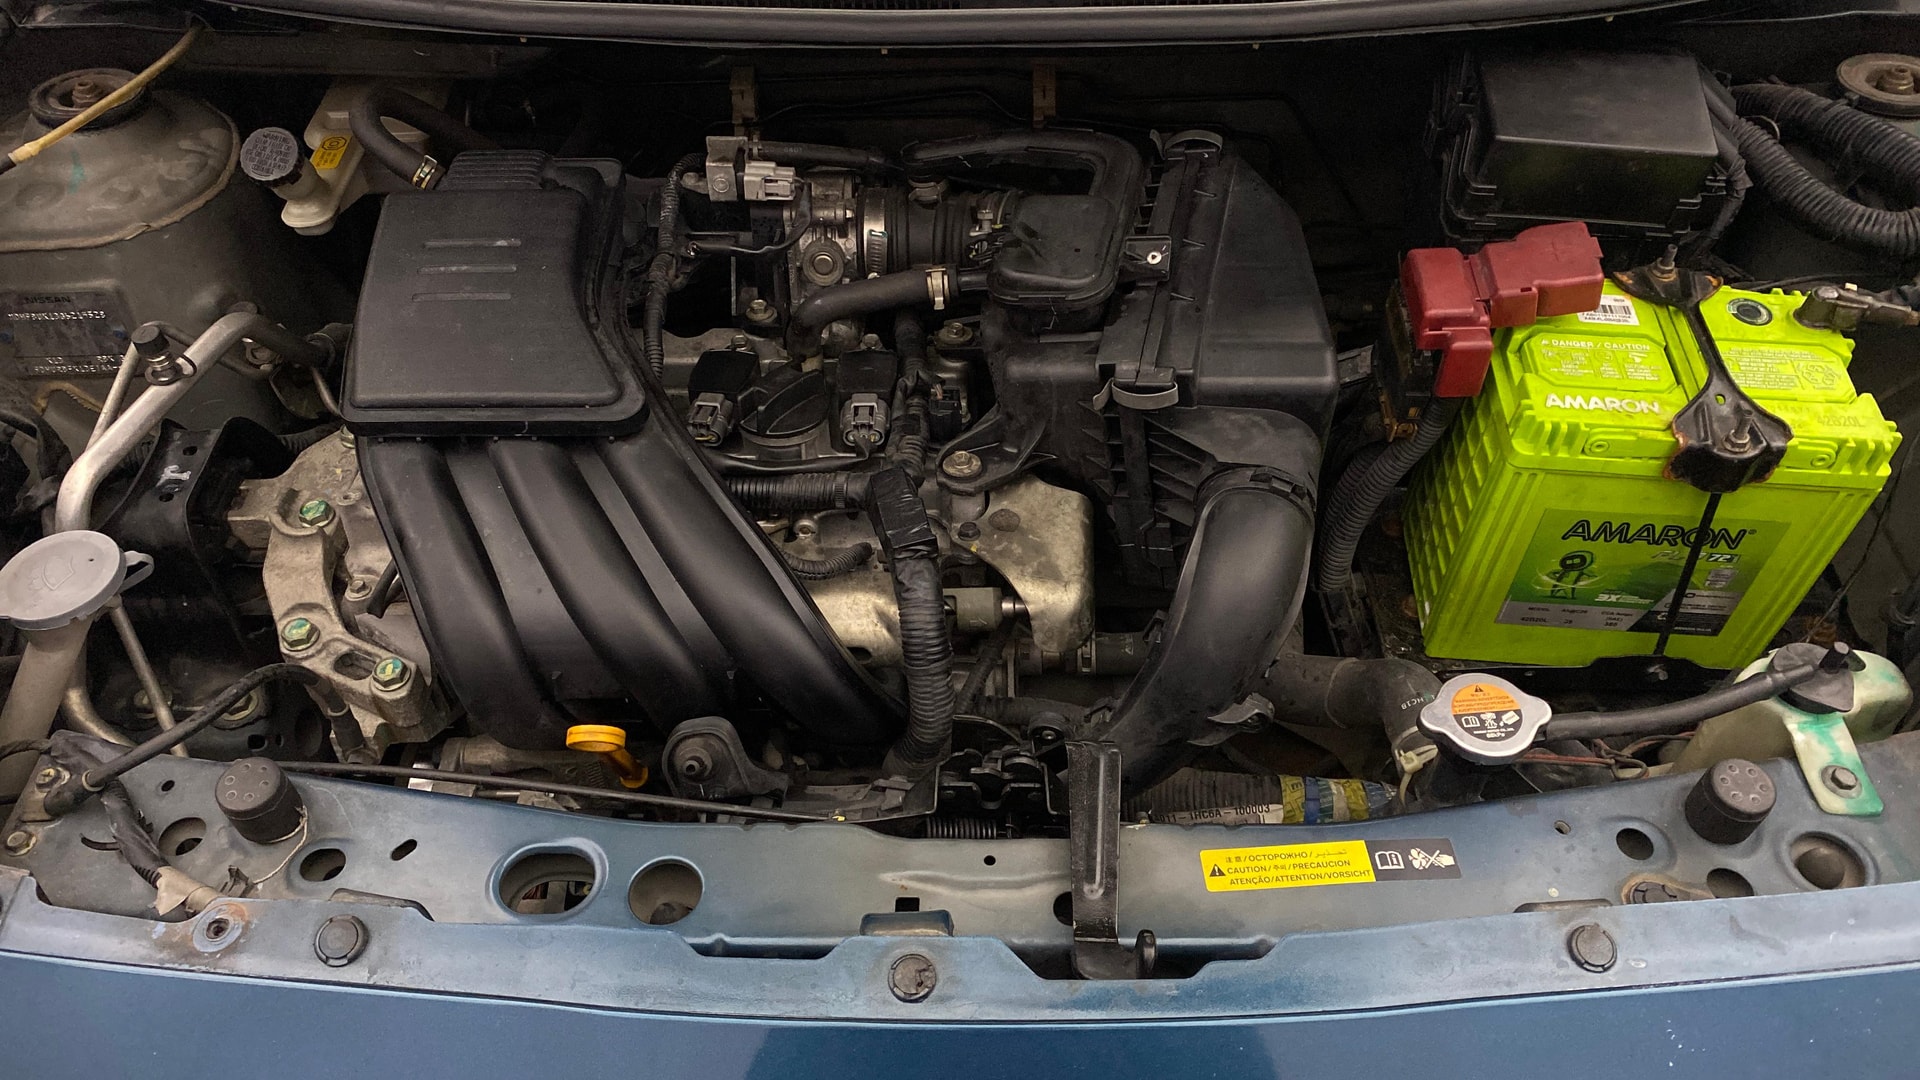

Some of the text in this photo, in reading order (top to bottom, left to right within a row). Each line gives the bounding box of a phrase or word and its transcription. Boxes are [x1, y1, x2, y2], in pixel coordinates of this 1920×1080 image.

[25, 296, 71, 304] NISSAN
[1551, 339, 1594, 348] DANGER
[1604, 342, 1650, 351] CAUTION
[1546, 394, 1660, 414] AMARON
[1234, 804, 1271, 815] 100003
[1248, 851, 1308, 862] ОСТОРОЖНО
[1227, 865, 1267, 874] CAUTION
[1293, 860, 1351, 870] PRECAUCION
